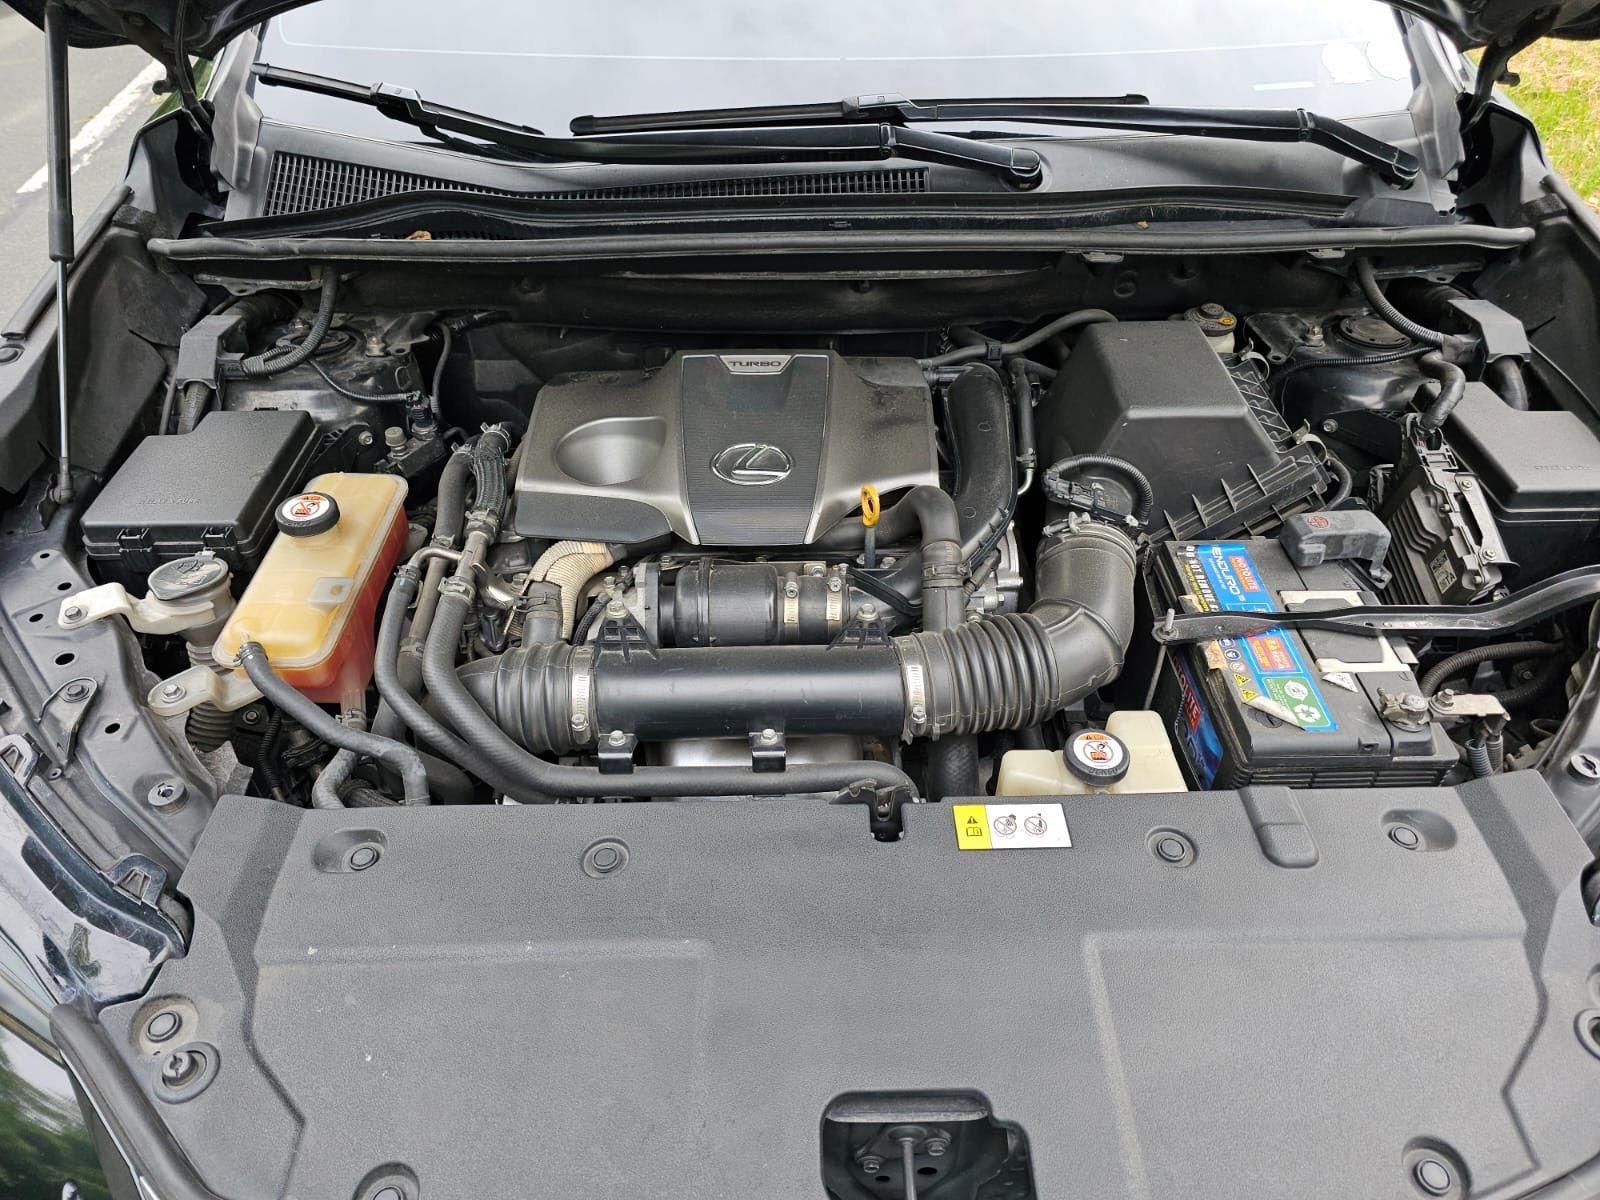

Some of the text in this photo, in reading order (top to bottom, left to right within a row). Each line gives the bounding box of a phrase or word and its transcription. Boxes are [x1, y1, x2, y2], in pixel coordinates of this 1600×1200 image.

[1185, 545, 1196, 557] DO
[1189, 559, 1203, 573] NOT
[1211, 546, 1241, 595] ENDURO
[1235, 556, 1258, 591] MOTOLITE
[1195, 574, 1216, 603] REMOVE
